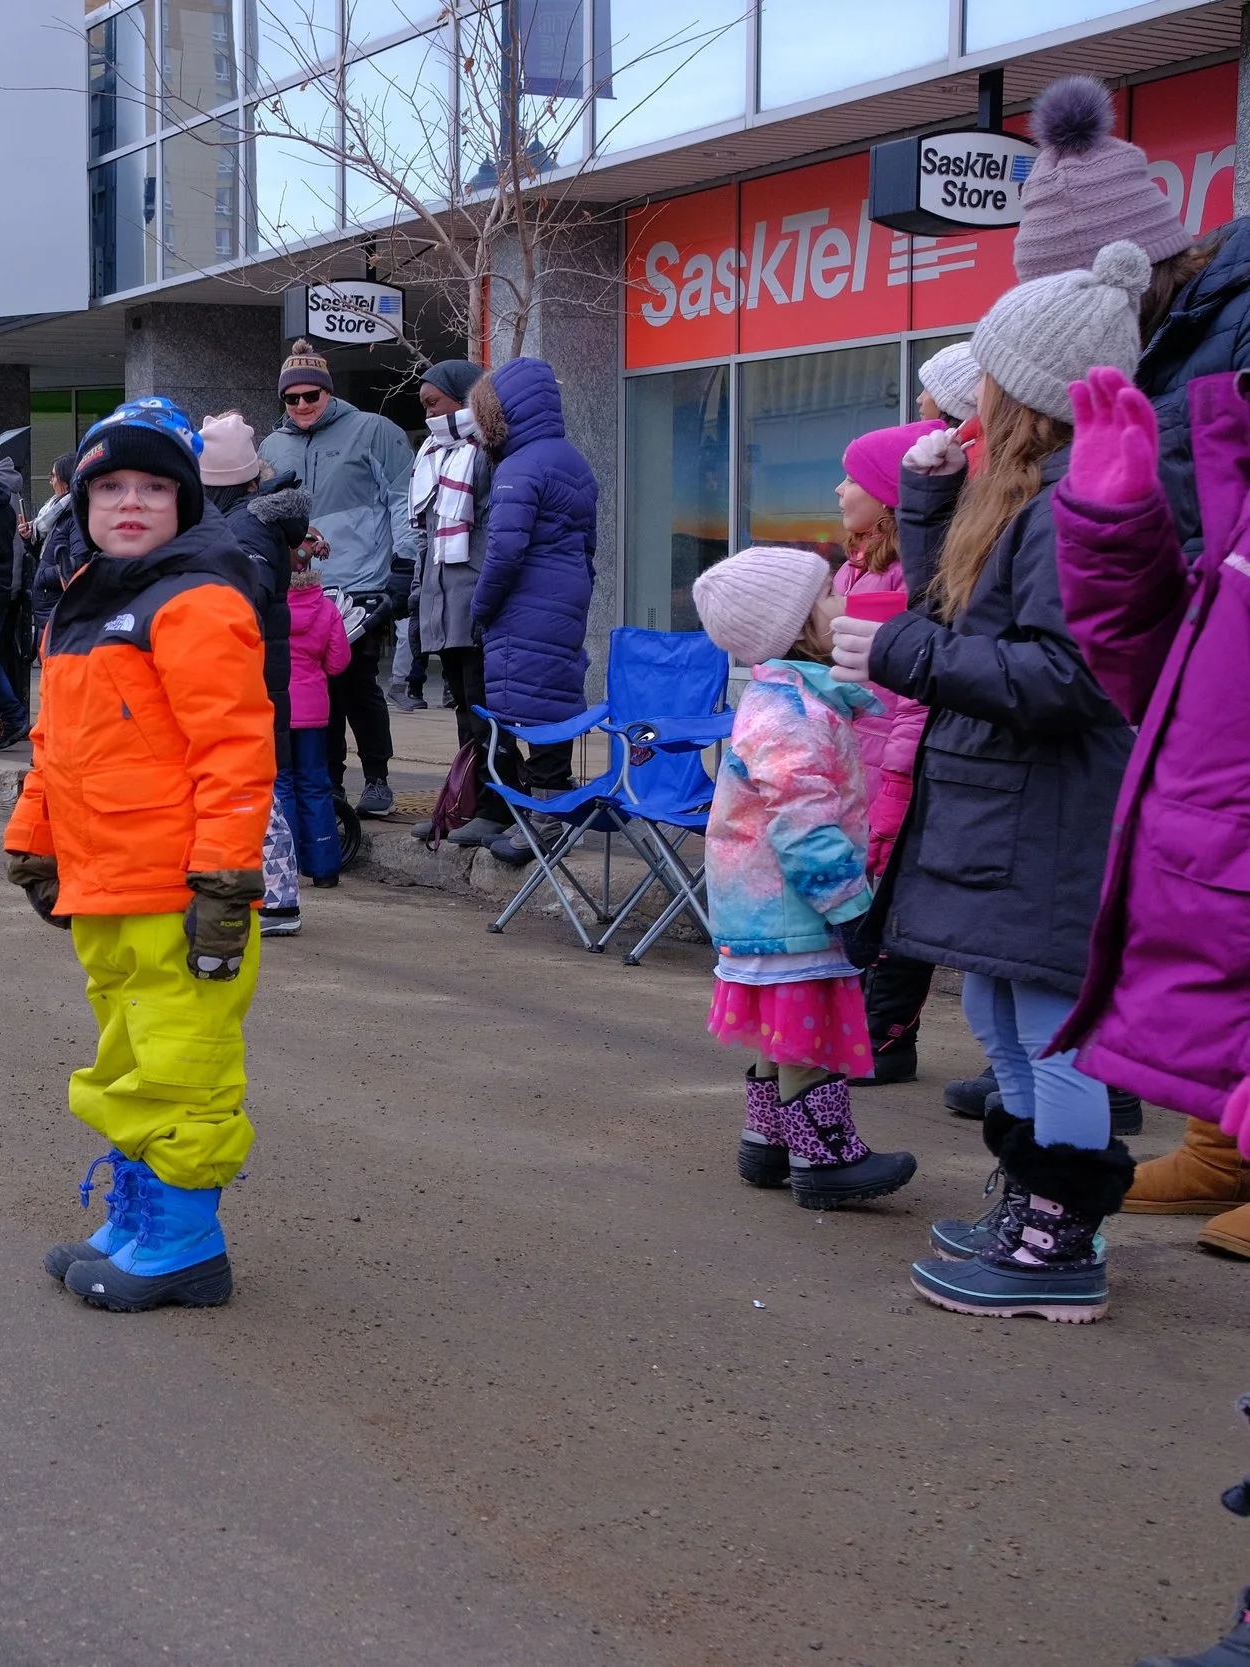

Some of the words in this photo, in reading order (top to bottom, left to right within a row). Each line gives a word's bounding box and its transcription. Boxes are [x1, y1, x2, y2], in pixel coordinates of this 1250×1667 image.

[921, 147, 1008, 180] SaskTel
[941, 180, 1007, 210] Store
[641, 199, 872, 327] SaskTel
[324, 314, 376, 333] Store
